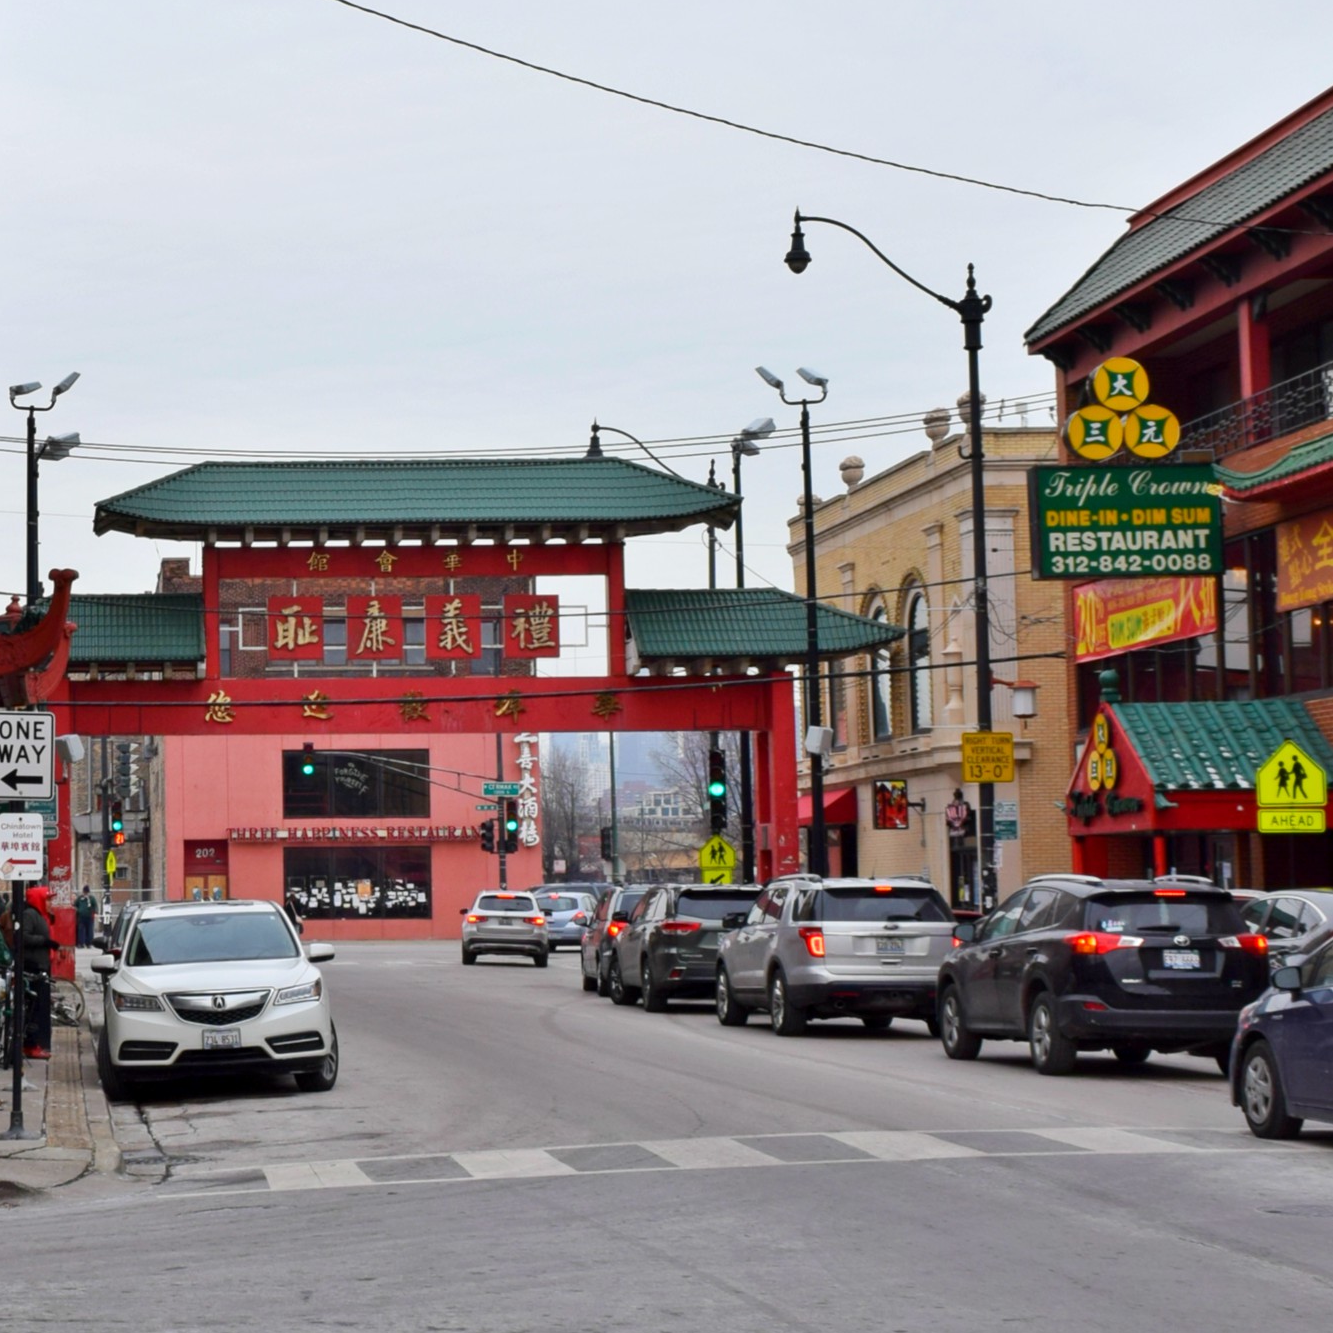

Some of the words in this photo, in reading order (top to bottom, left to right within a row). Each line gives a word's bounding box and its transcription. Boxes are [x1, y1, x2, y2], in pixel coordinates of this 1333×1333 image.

[1044, 471, 1119, 507] Triple
[1127, 470, 1210, 498] Crown
[1046, 509, 1118, 527] DINE-IN
[1132, 508, 1167, 525] DIM
[1171, 507, 1212, 524] SUM
[1049, 528, 1210, 552] RESTAURANT
[1051, 553, 1212, 573] 312-842-0088
[0, 720, 45, 740] ONE
[965, 736, 987, 744] RIGHT
[991, 736, 1011, 744] TURN
[971, 746, 1005, 755] VERTICAL
[967, 755, 1010, 764] CLEARANCE
[1, 822, 42, 830] Chinatown
[1270, 814, 1314, 827] AHEAD
[226, 826, 280, 843] THREE
[286, 825, 380, 843] HAPPINESS
[385, 824, 482, 842] RESTAURAN
[196, 848, 216, 858] 202
